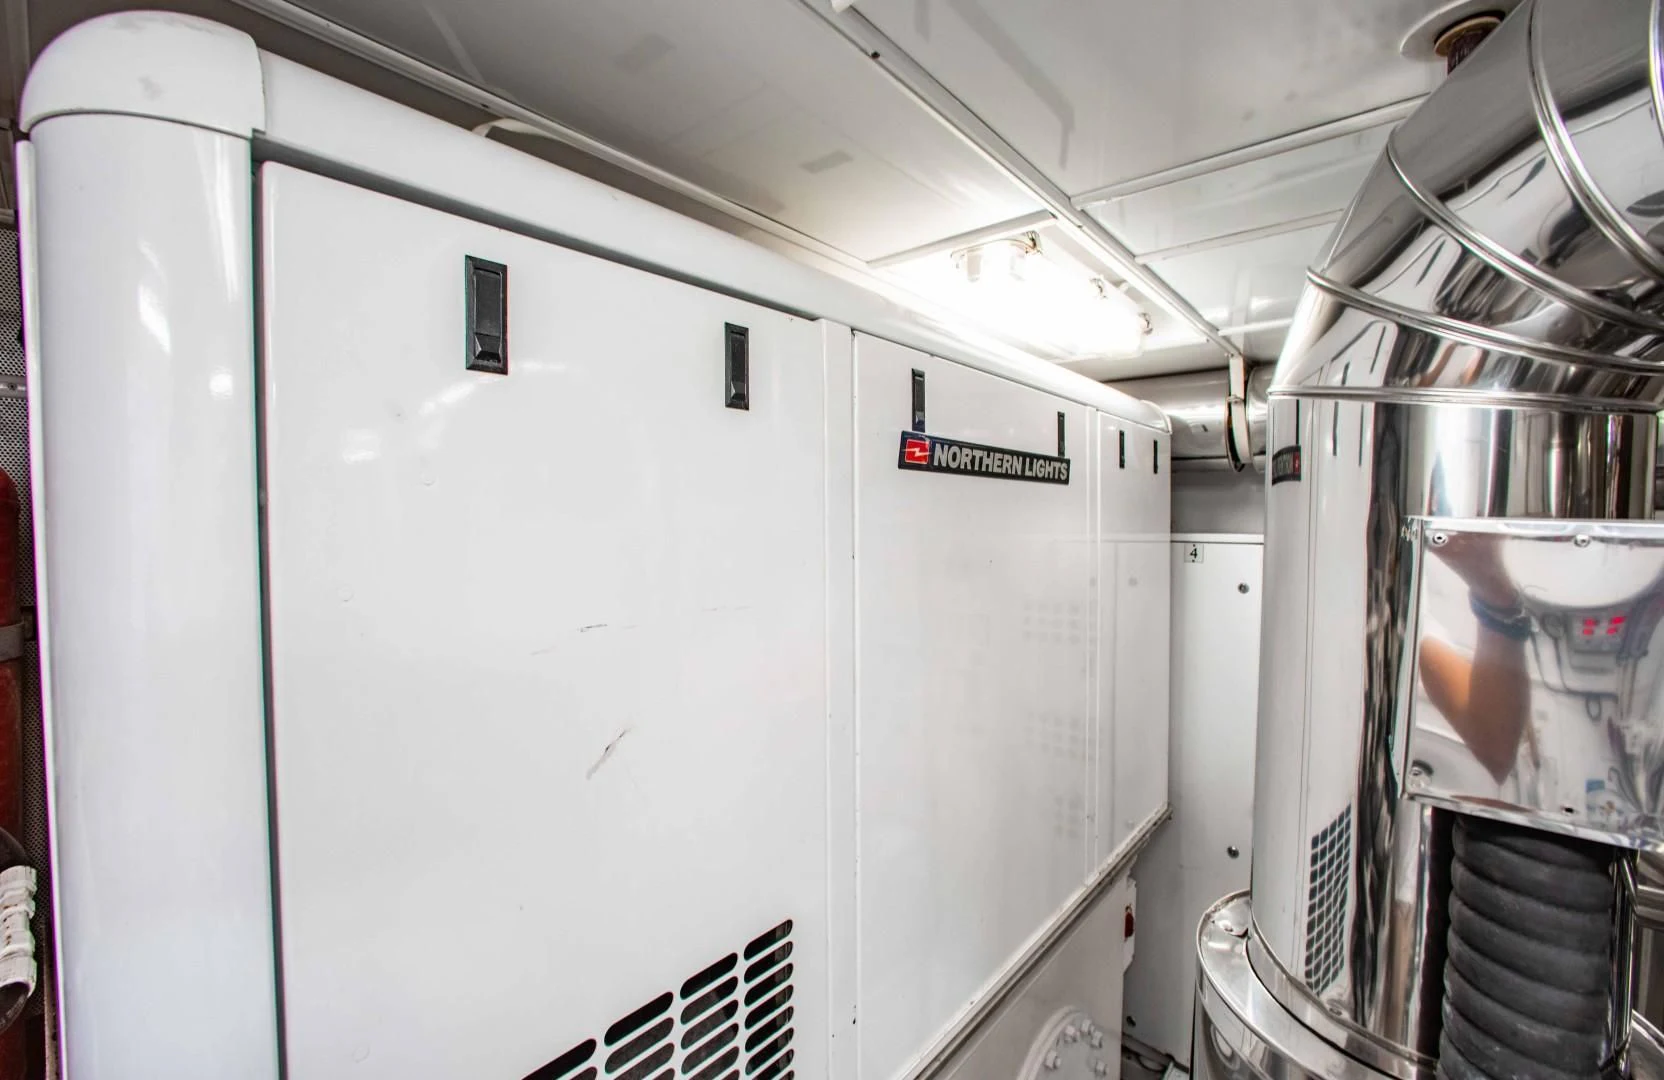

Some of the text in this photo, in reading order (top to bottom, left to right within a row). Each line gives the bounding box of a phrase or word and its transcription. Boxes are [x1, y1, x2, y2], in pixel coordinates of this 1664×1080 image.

[933, 443, 1068, 481] NORTHERN LIGHTS
[1189, 547, 1199, 559] 4
